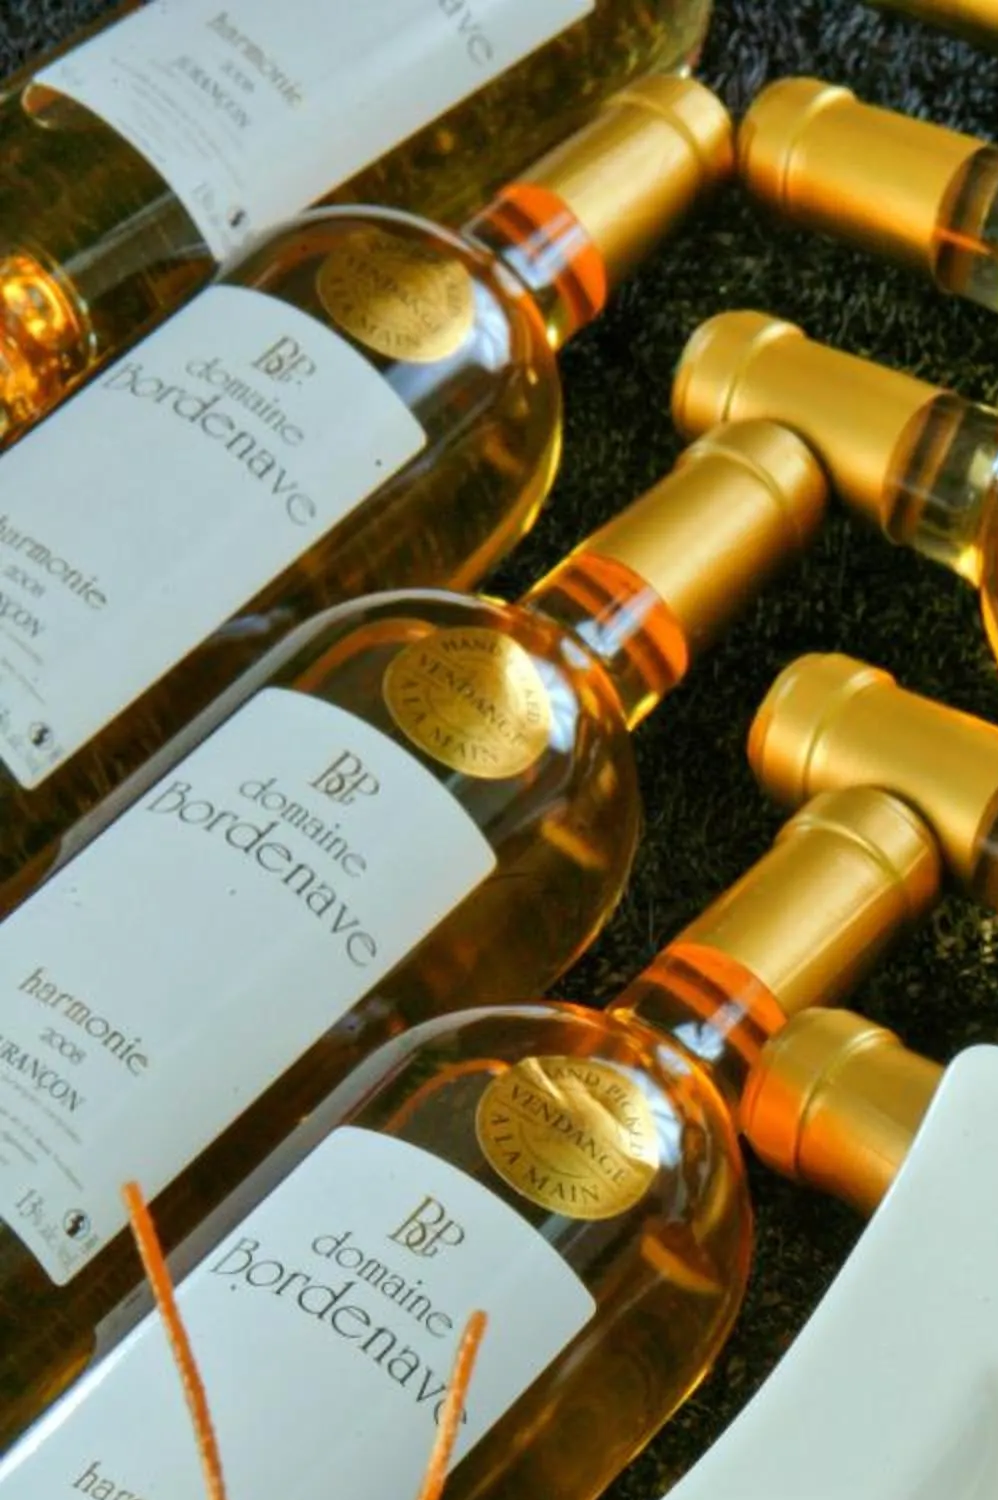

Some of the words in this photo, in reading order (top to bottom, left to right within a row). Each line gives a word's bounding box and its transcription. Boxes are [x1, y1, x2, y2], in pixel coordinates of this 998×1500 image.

[102, 362, 317, 526] Bordenave
[185, 357, 305, 447] domaine
[146, 780, 377, 968] Bordenave
[238, 777, 367, 878] domaine
[17, 966, 149, 1077] harmonie
[511, 1084, 627, 1186] VENDANGE
[526, 1165, 600, 1203] MAIN
[311, 1231, 453, 1338] domaine
